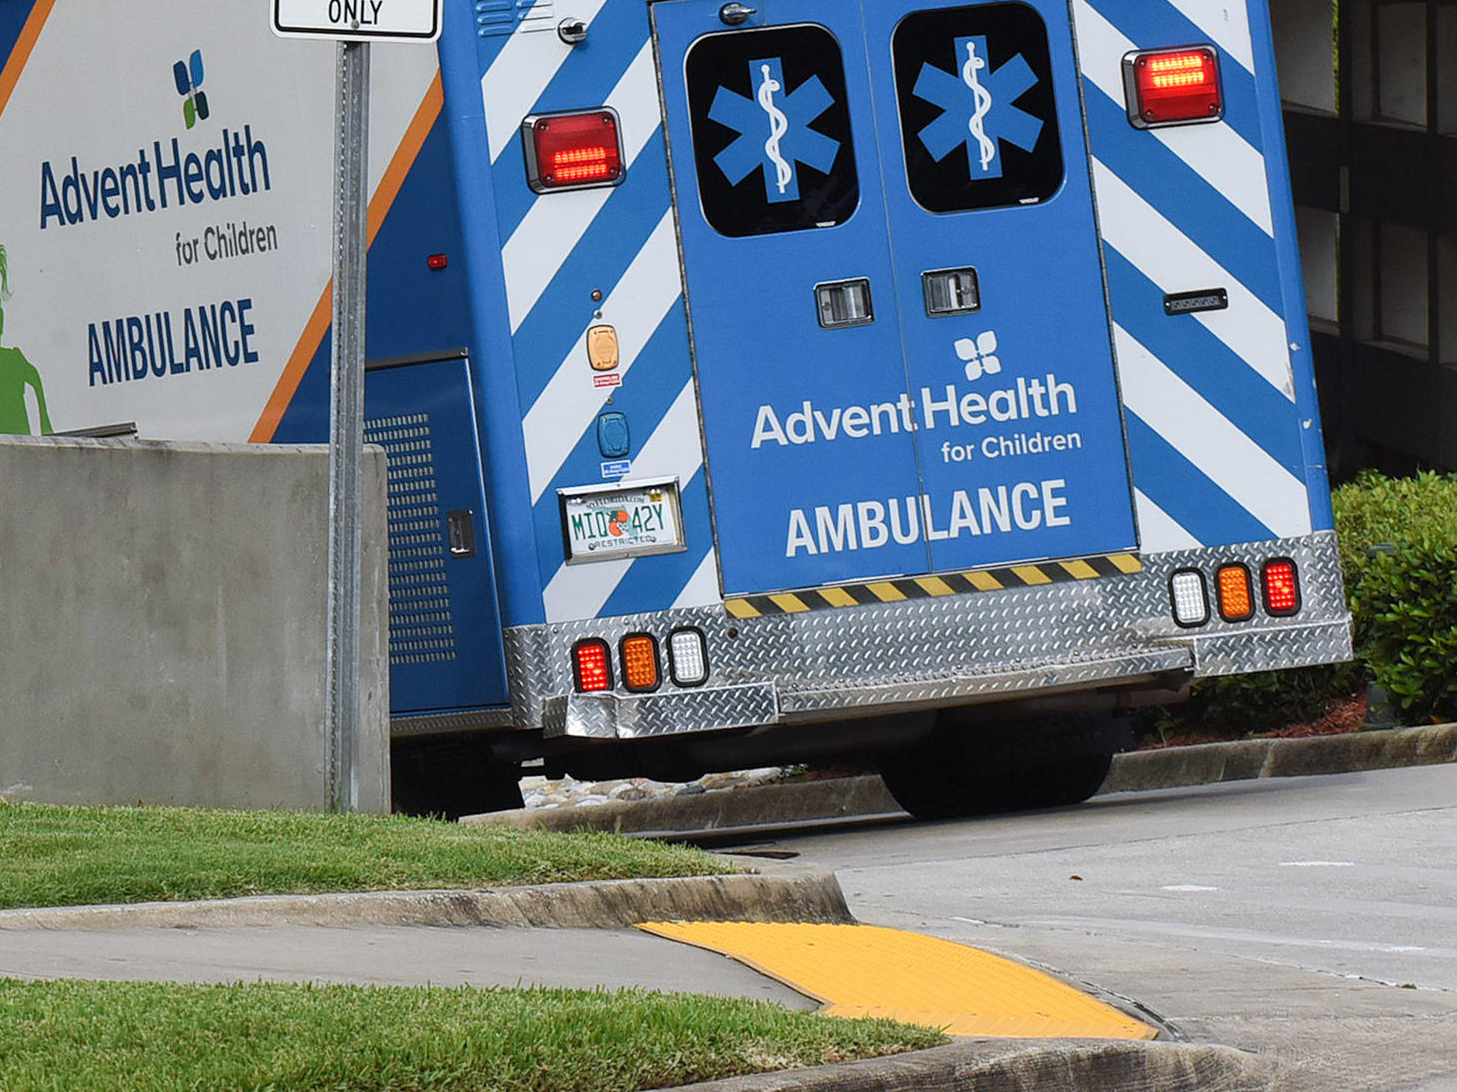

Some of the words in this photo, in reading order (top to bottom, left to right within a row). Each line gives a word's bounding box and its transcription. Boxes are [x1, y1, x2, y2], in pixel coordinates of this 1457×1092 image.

[40, 125, 270, 230] AdventHealth
[176, 232, 199, 266] for
[203, 221, 278, 263] Children
[88, 299, 258, 387] AMBULANCE
[750, 374, 1078, 449] AdventHealth
[941, 442, 975, 462] for
[981, 431, 1082, 459] Children
[632, 503, 664, 533] 42Y
[785, 479, 1071, 558] AMBULANCE
